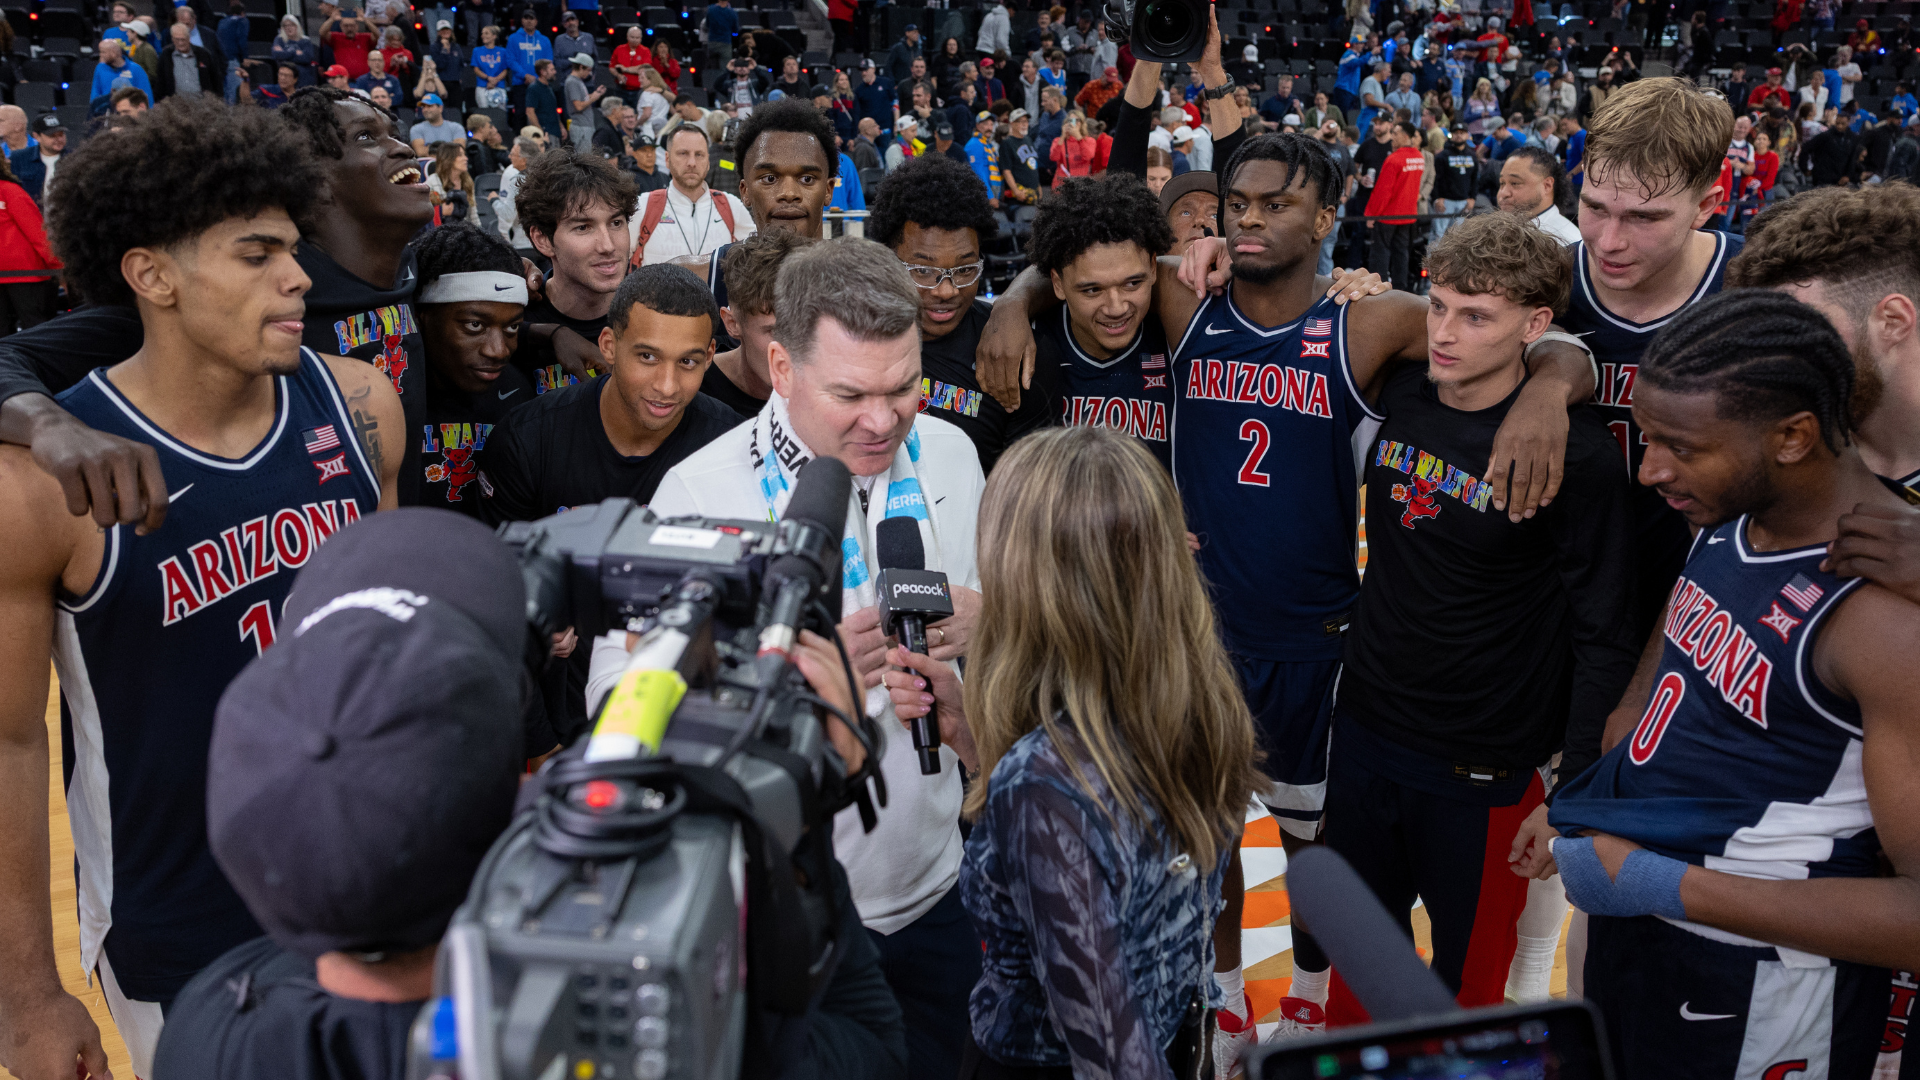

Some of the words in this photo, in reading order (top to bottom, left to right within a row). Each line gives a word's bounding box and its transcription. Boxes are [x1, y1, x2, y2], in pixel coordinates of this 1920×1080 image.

[334, 312, 382, 355] BILL
[1303, 341, 1329, 356] XII
[920, 377, 983, 418] ALTON
[1144, 374, 1166, 388] XII
[1186, 359, 1333, 419] ARIZONA
[316, 454, 350, 481] XII
[1237, 418, 1271, 488] 2
[1375, 439, 1415, 475] BILL
[1415, 449, 1494, 513] WALTON
[892, 582, 945, 599] peacock
[1761, 603, 1800, 640] XII
[1663, 575, 1774, 730] ARIZONA
[1629, 671, 1686, 766] 0
